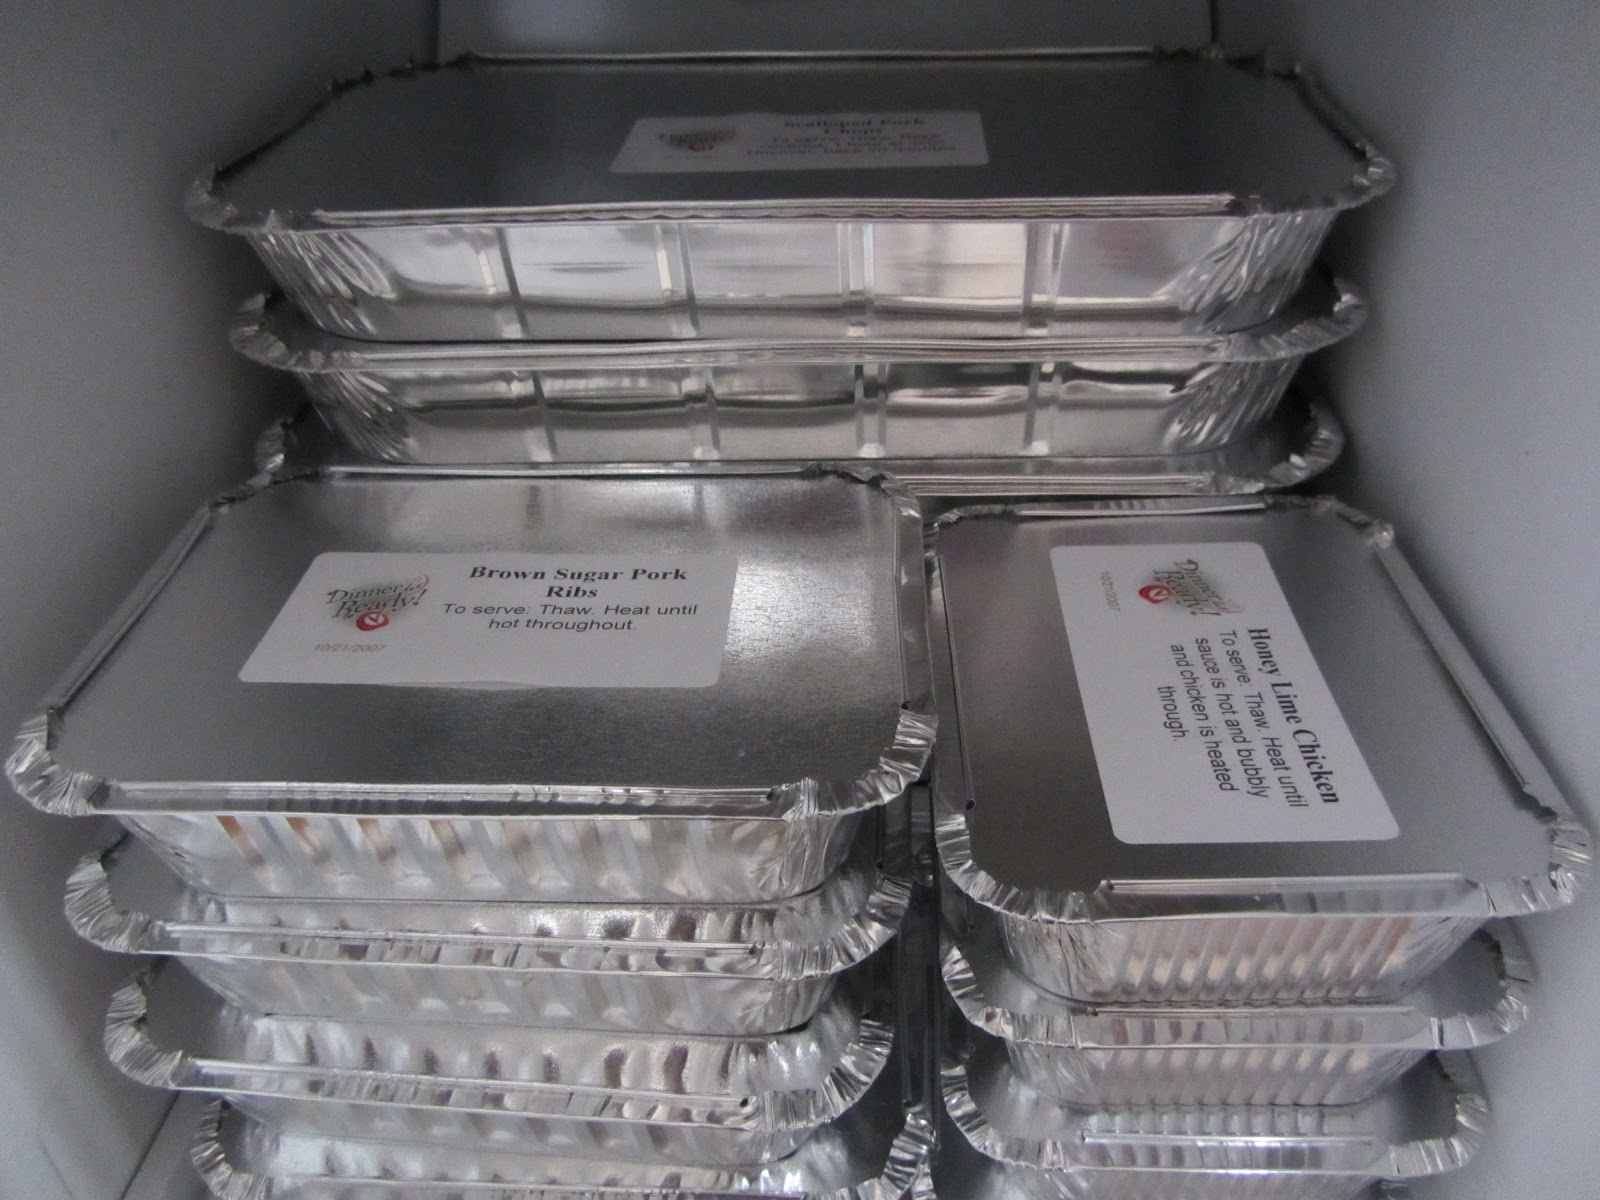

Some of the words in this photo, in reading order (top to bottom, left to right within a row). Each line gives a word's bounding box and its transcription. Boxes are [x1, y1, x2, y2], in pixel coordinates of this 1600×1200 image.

[470, 566, 546, 580] Brown
[554, 568, 624, 583] Sugar
[631, 568, 687, 580] Pork
[326, 584, 403, 604] Dinner
[332, 589, 428, 618] Ready!
[545, 586, 598, 598] Ribs
[443, 603, 466, 614] To
[472, 605, 529, 615] serve:
[539, 605, 595, 615] Thaw.
[604, 605, 651, 615] Heat
[657, 604, 698, 615] until
[488, 619, 519, 629] hot
[526, 619, 637, 632] throughout.
[1219, 630, 1237, 647] To
[1171, 644, 1194, 667] and
[1196, 637, 1220, 674] sauce
[1227, 650, 1252, 687] serve:
[1180, 670, 1209, 721] chicken
[1211, 677, 1225, 689] is
[1158, 685, 1190, 741] through.
[1216, 693, 1238, 715] hot
[1244, 692, 1270, 732] Thaw.
[1248, 628, 1281, 676] Honey
[1271, 682, 1302, 724] Lime
[1292, 729, 1340, 804] Chicken
[1198, 725, 1214, 737] is
[1225, 719, 1252, 744] and
[1204, 740, 1240, 792] heated
[1262, 737, 1291, 772] Heat
[1236, 748, 1270, 798] bubbly
[1278, 775, 1309, 807] until
